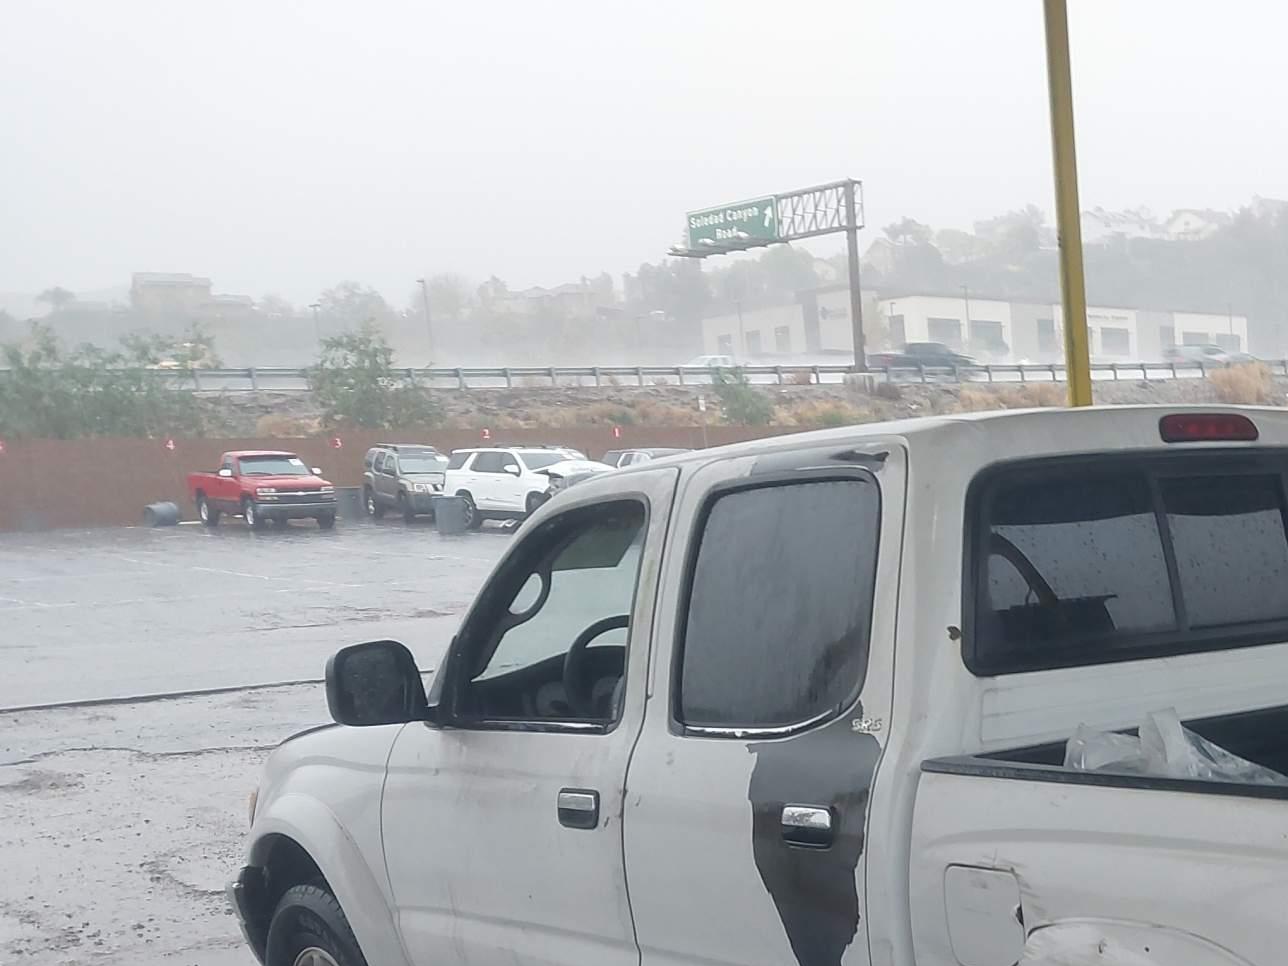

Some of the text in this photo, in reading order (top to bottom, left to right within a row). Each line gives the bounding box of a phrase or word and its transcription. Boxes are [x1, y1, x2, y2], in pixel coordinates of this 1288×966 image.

[690, 206, 760, 229] Soledad Canyon
[715, 226, 738, 240] Road
[335, 438, 342, 449] 3
